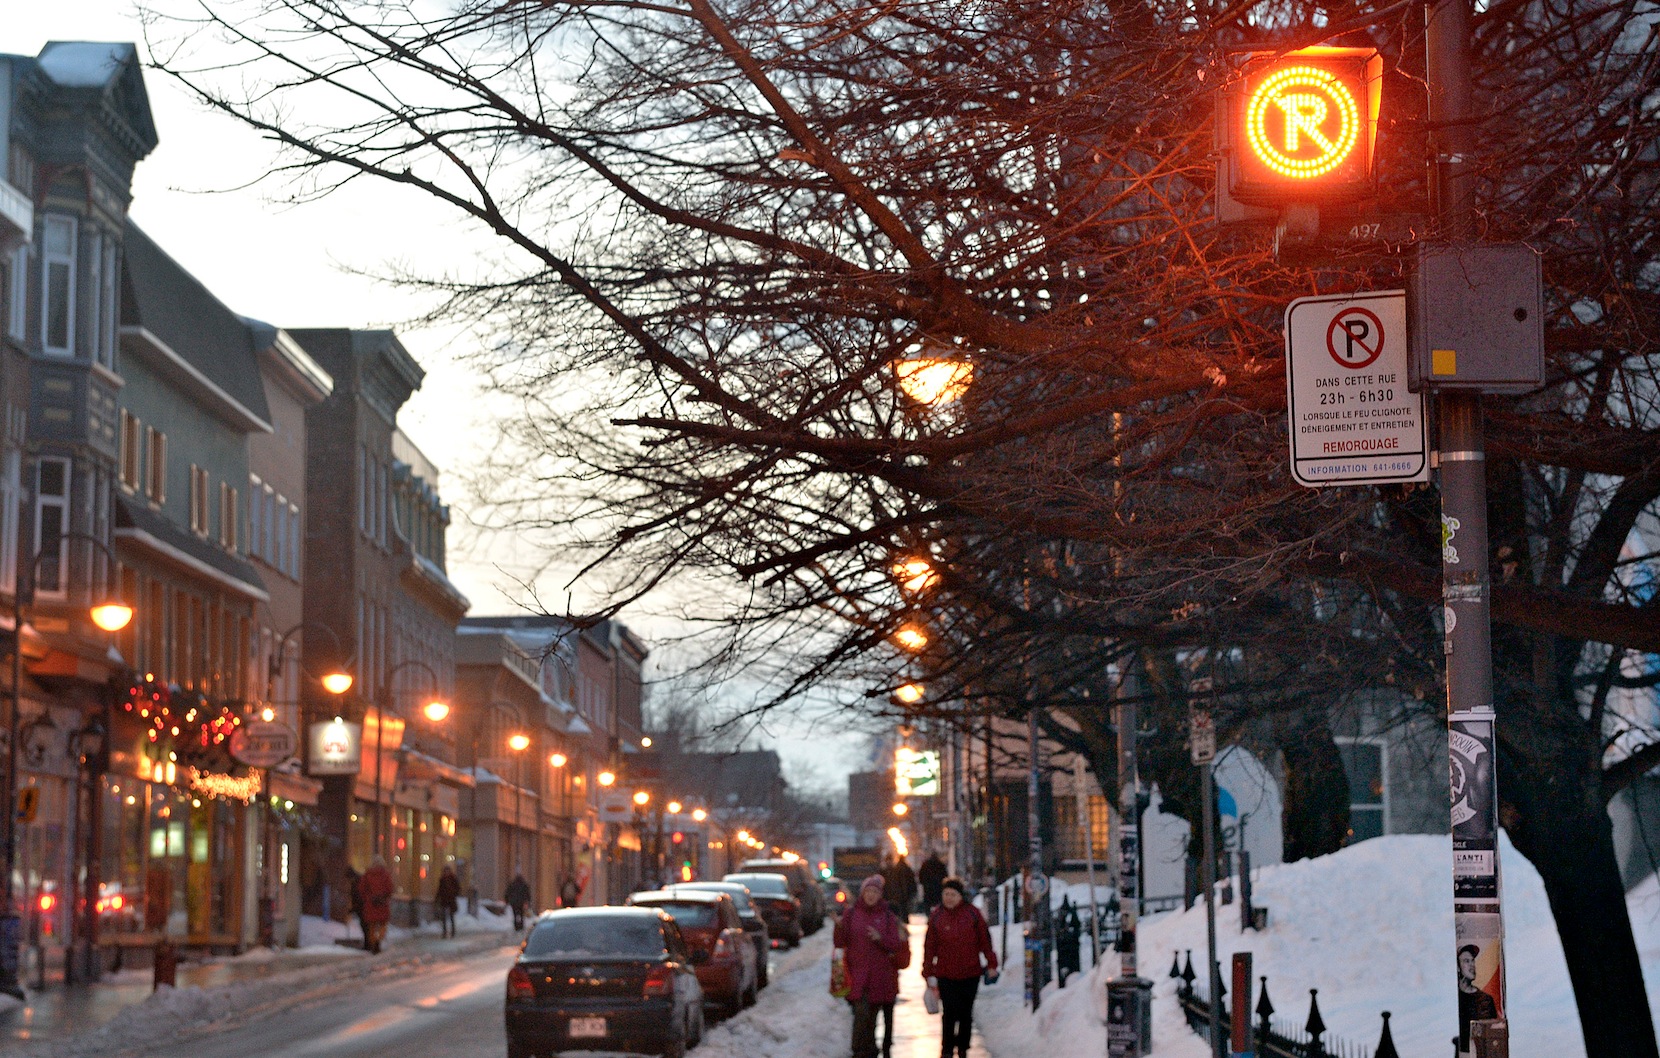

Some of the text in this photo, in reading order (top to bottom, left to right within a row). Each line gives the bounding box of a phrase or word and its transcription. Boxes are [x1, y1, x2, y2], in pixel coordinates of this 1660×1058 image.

[1349, 223, 1381, 239] 497
[1316, 373, 1397, 388] DANS CETTE RUE
[1320, 392, 1345, 405] 23h
[1359, 389, 1394, 403] 6h30
[1303, 407, 1412, 421] LORSQUE LE FEU CLIGNOTE
[1301, 420, 1415, 434] DÉNEIGEMENT ET ENTRETIEN
[1323, 437, 1399, 453] REMORQUAGE
[1308, 461, 1412, 475] INFORMATION 641-6666
[1456, 854, 1484, 862] L'ANTI
